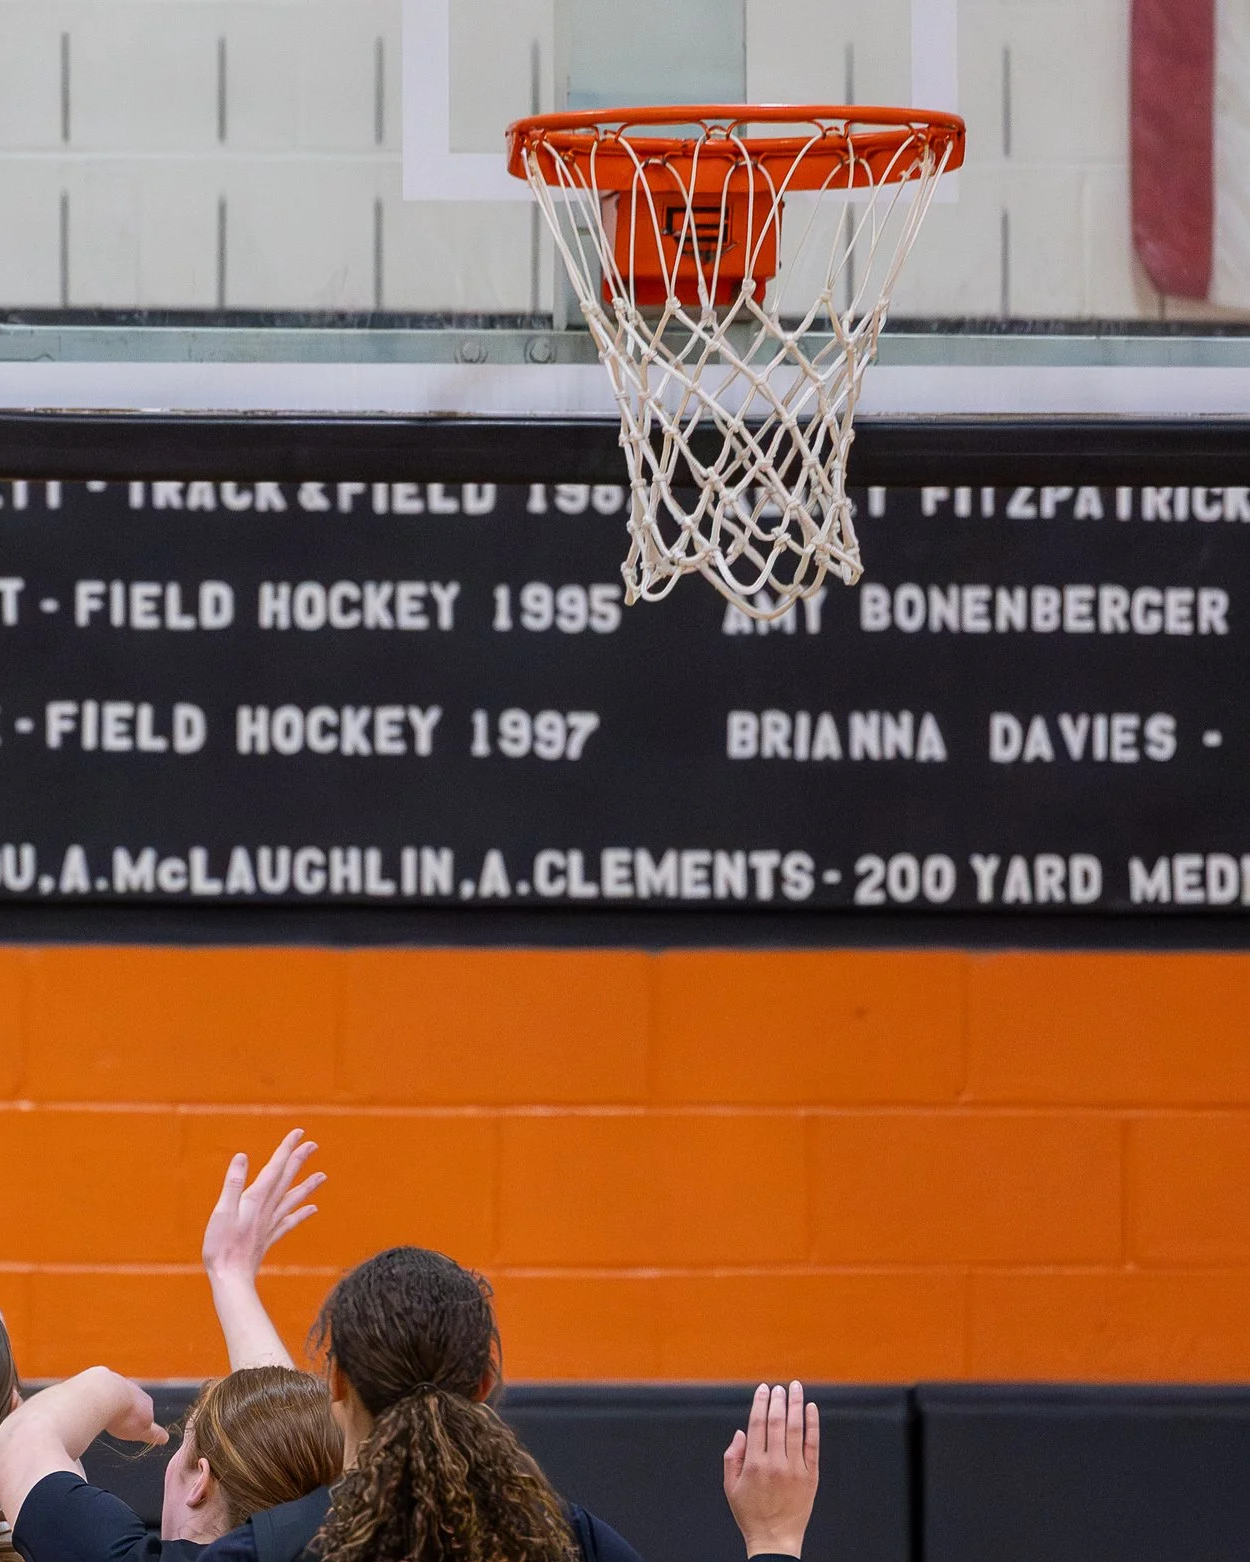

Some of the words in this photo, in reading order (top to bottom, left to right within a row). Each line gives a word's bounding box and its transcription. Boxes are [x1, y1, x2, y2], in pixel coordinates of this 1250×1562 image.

[74, 580, 235, 631] FIELD
[258, 580, 461, 631] HOCKEY
[493, 582, 622, 634] 1995
[722, 585, 827, 635] AMY
[860, 583, 1229, 636] BONENBERGER
[45, 700, 207, 754] FIELD
[236, 704, 442, 757] HOCKEY
[471, 709, 600, 761] 1997
[726, 710, 947, 762] BRIANNA
[989, 712, 1177, 764] DAVIES
[854, 853, 956, 905] 200
[970, 854, 1102, 904] YARD
